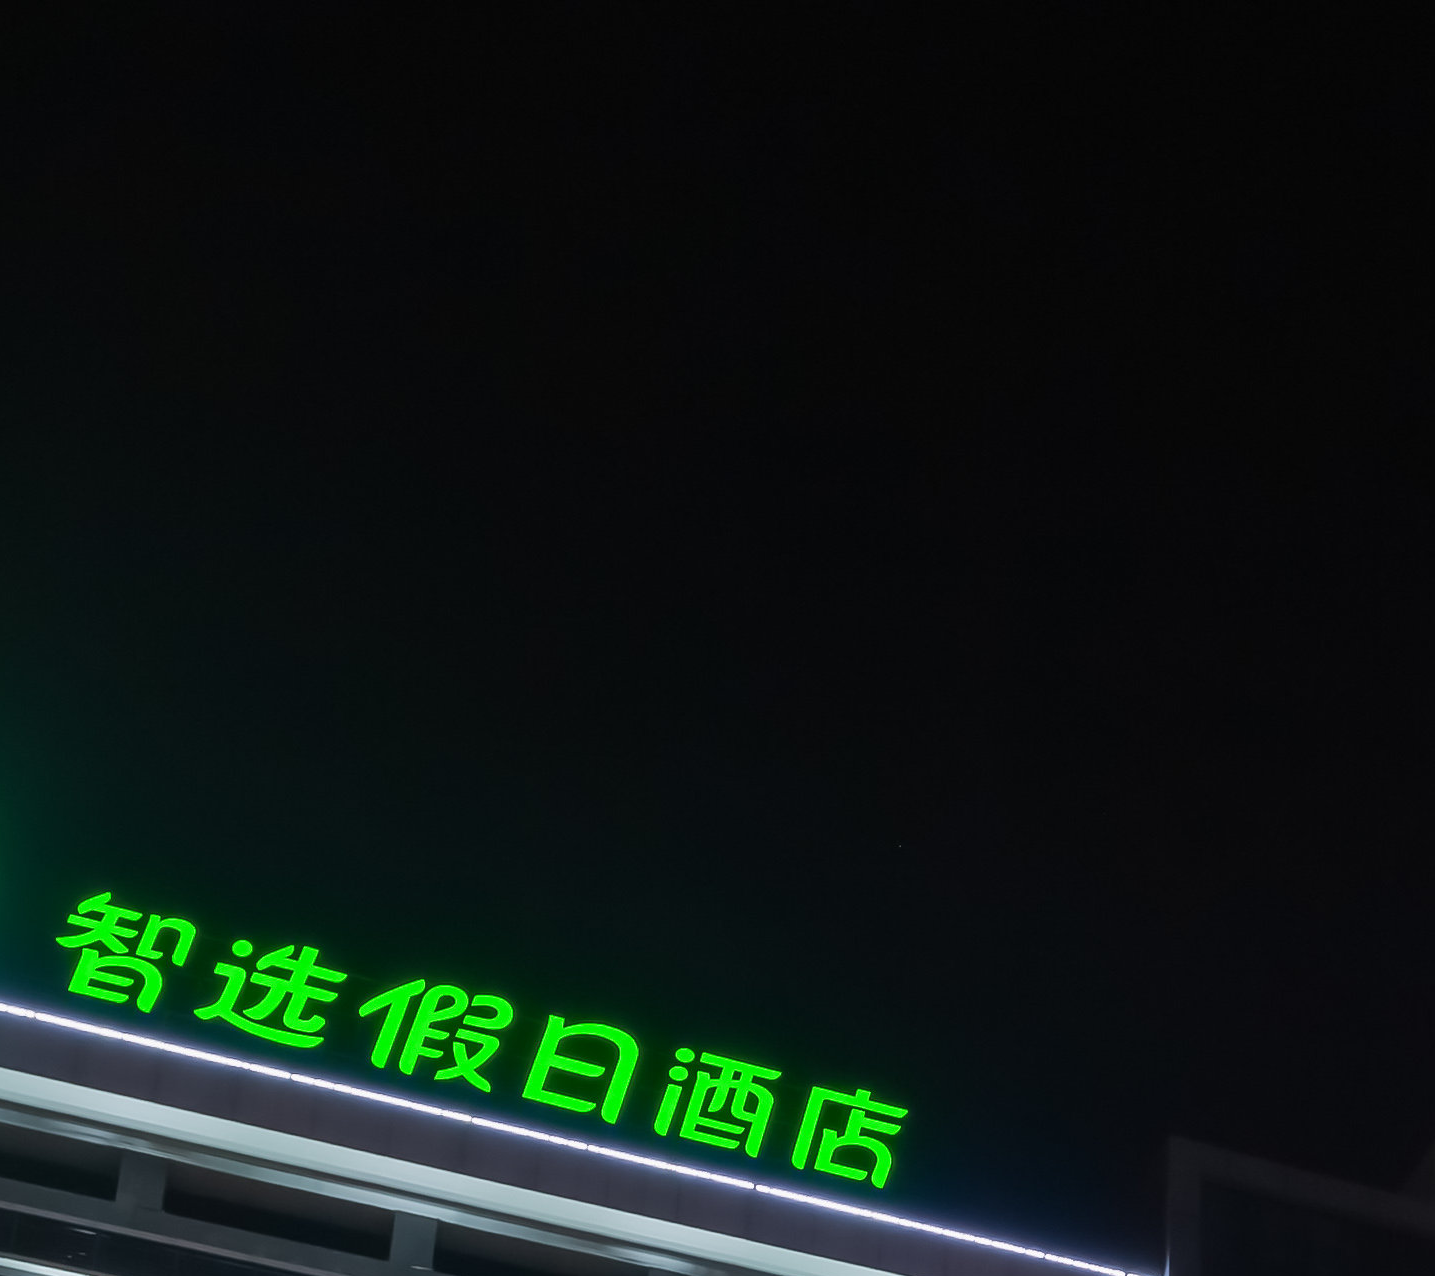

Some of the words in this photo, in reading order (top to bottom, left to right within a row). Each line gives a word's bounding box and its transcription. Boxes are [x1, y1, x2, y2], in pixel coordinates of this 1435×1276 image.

[55, 892, 908, 1187] 智选假日酒店
